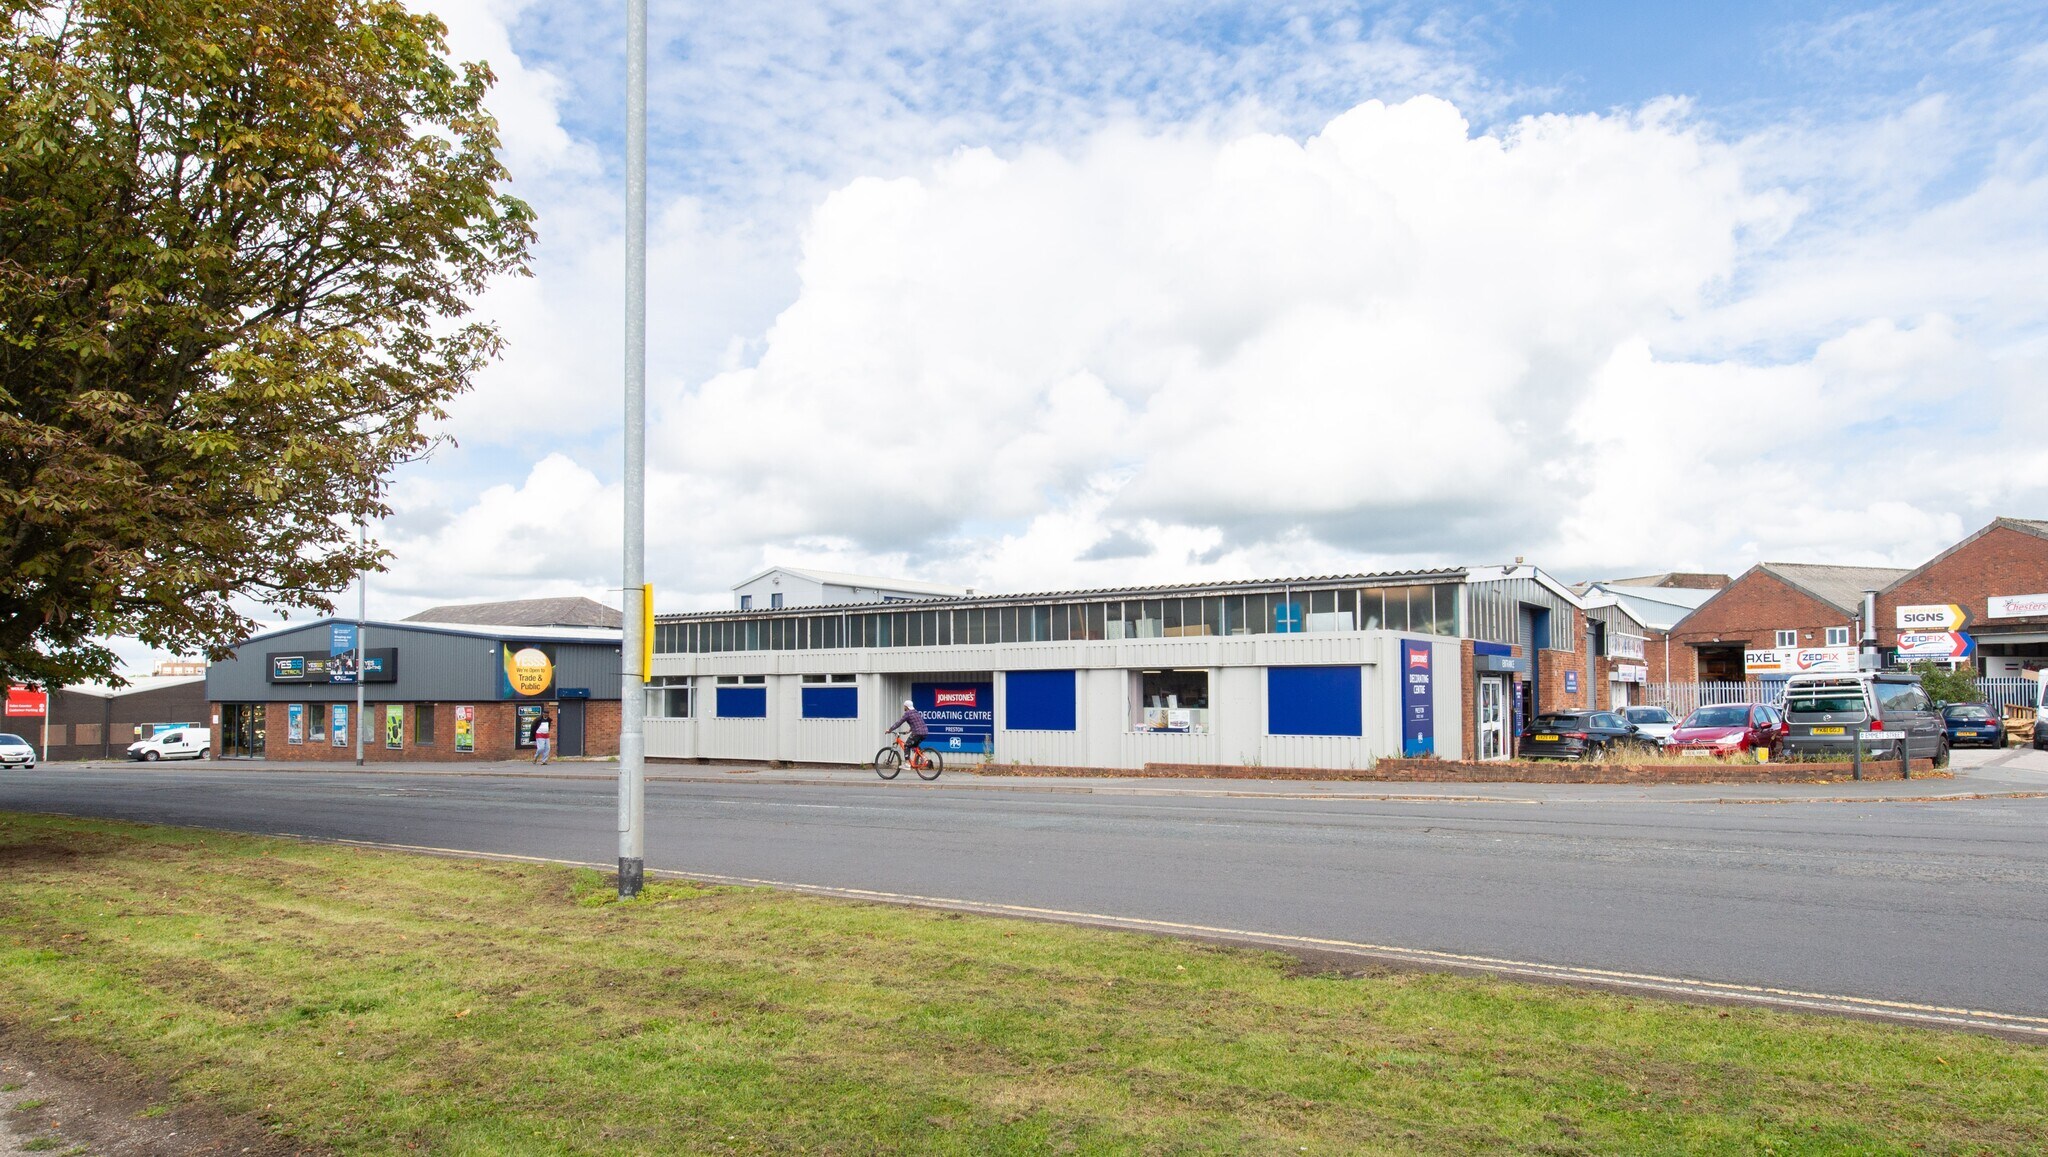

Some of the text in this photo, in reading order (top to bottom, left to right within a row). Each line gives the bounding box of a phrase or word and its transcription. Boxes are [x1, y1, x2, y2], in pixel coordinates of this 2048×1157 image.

[2006, 603, 2047, 611] Chesters
[1904, 613, 1944, 622] SIGNS
[1746, 650, 1781, 663] AXËL
[276, 660, 303, 669] YESSS
[519, 674, 543, 682] Trade &
[521, 682, 541, 690] Public
[937, 692, 975, 704] JOHNSTONE'S
[919, 711, 992, 720] DECORATING CENTRE
